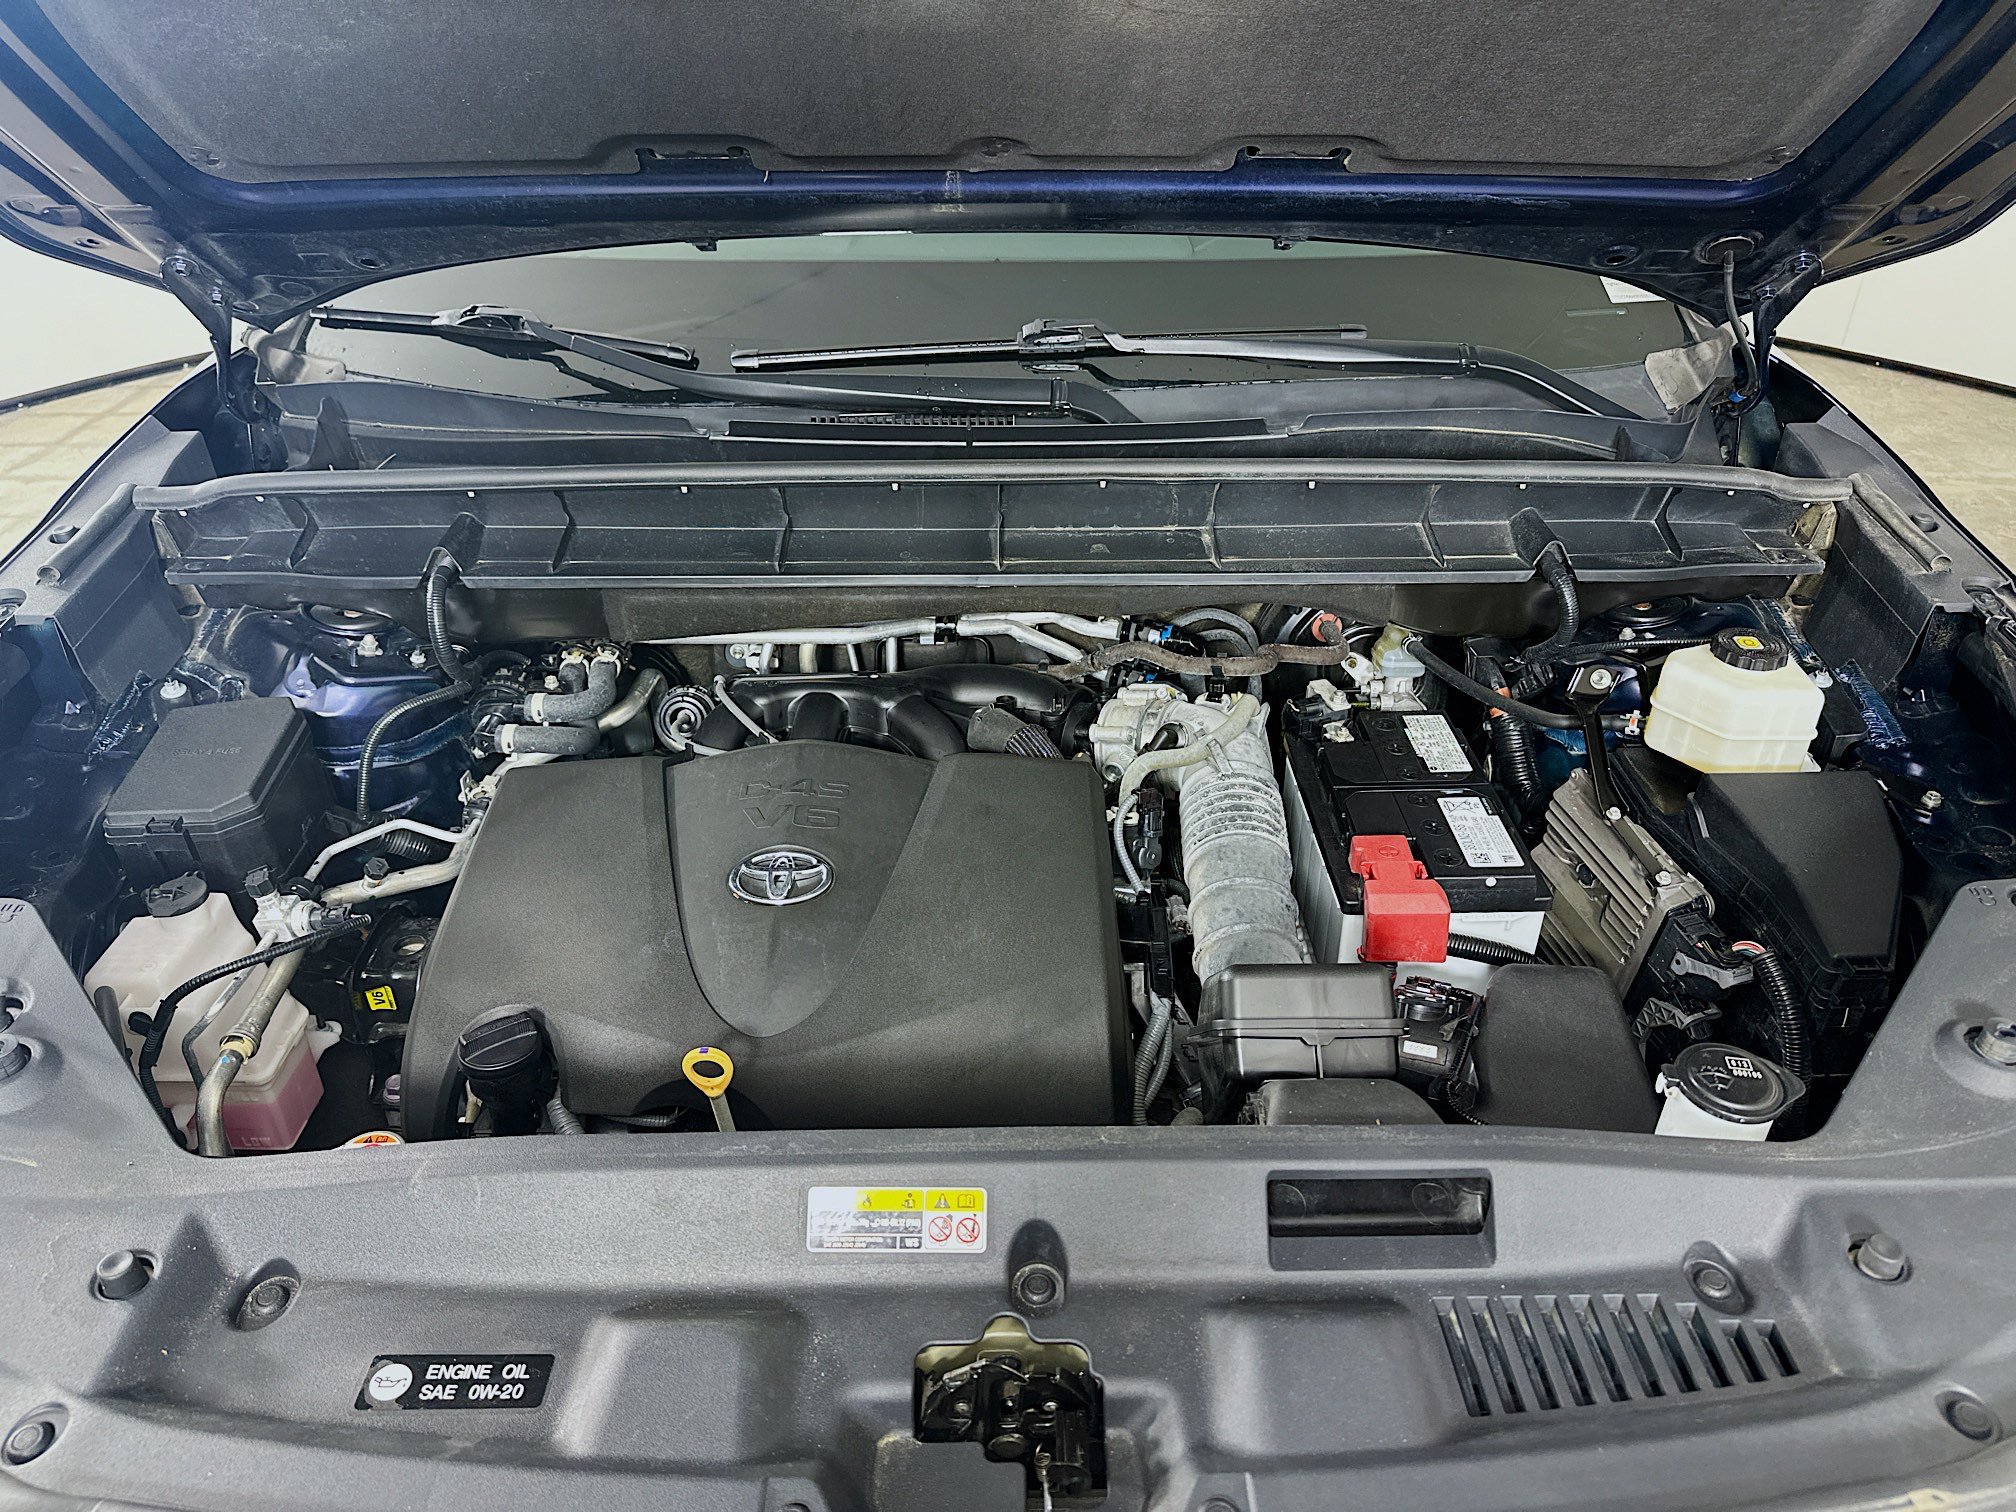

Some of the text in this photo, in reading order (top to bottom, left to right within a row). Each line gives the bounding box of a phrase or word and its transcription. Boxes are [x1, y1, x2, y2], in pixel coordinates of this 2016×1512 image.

[742, 804, 841, 829] V6
[372, 991, 386, 1006] V6
[240, 1136, 272, 1147] LOW
[425, 1363, 531, 1380] ENGINE OIL
[418, 1383, 525, 1400] SAE 0W-20
